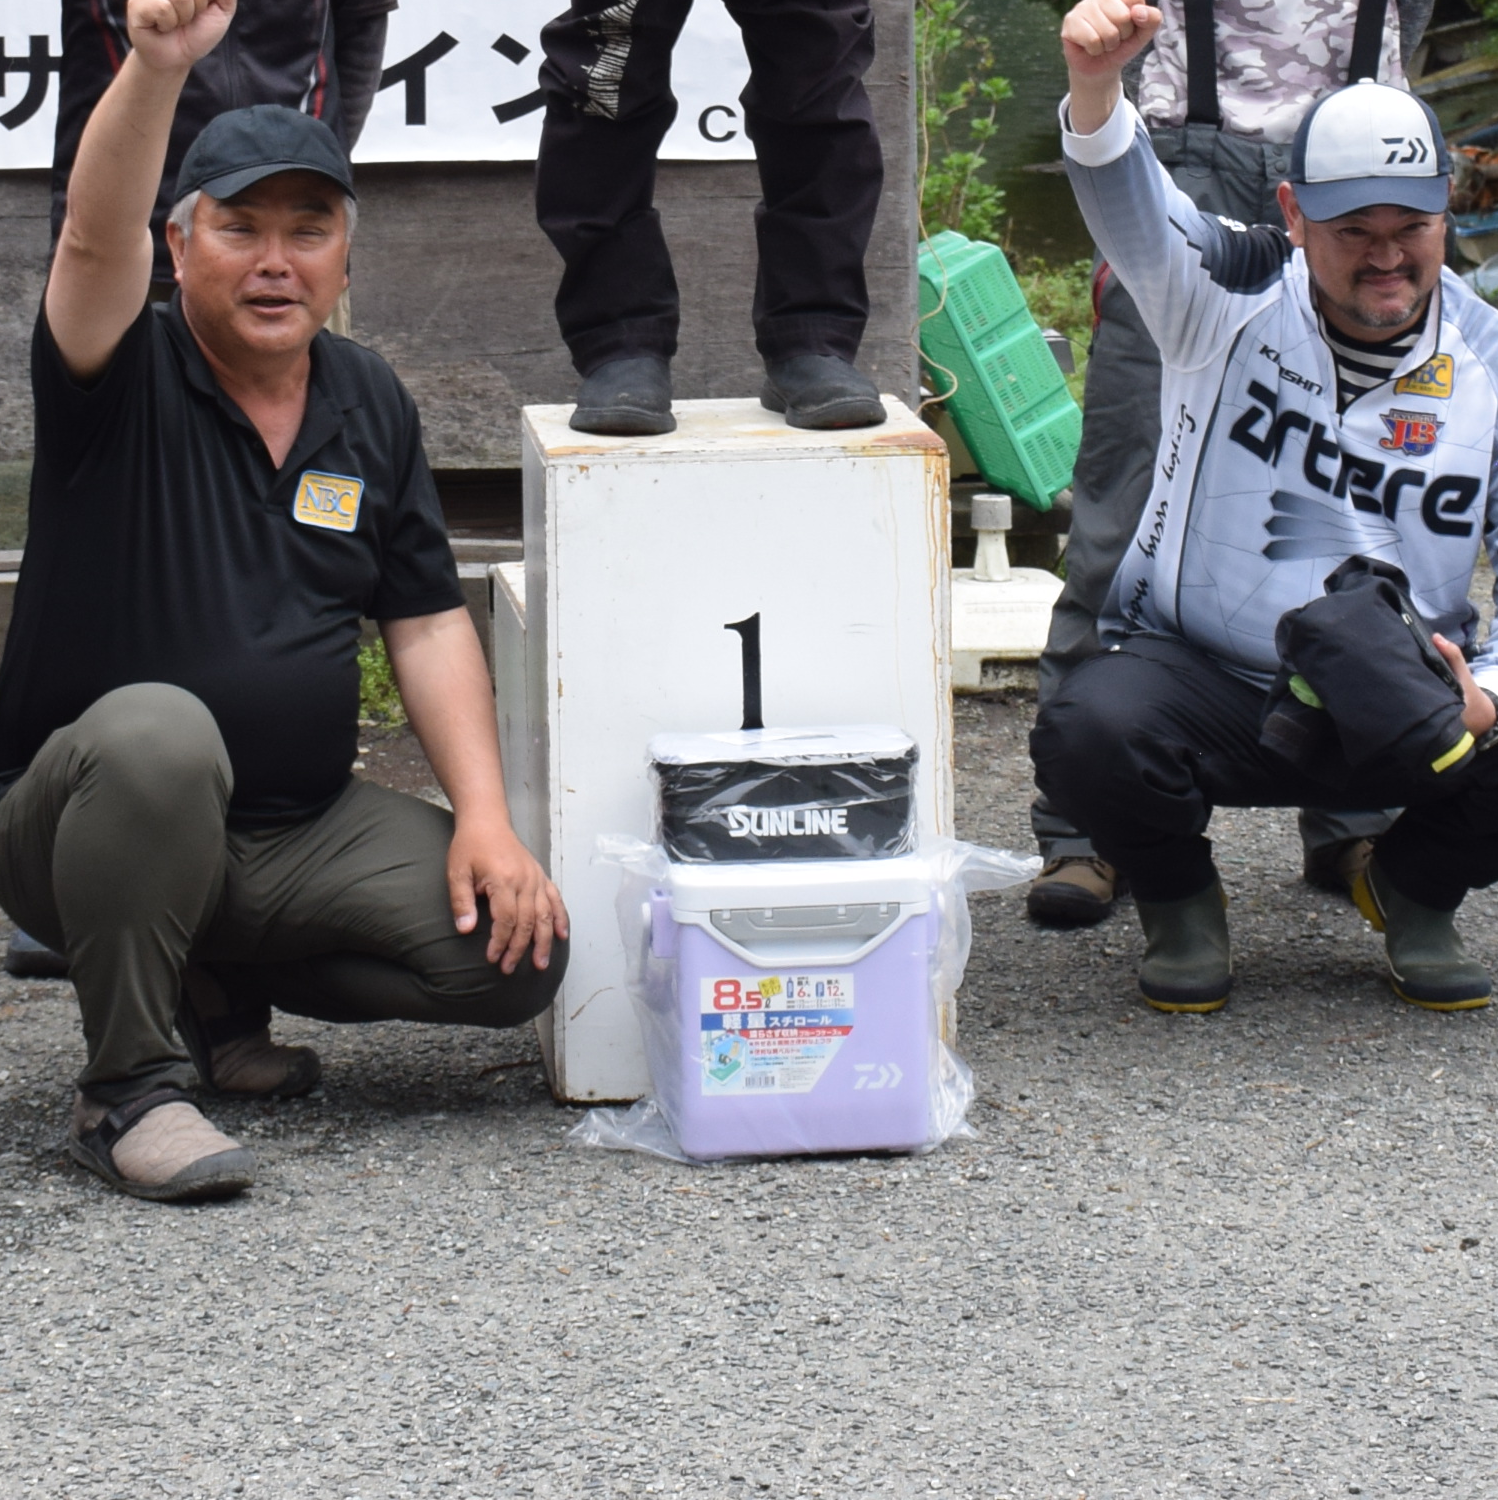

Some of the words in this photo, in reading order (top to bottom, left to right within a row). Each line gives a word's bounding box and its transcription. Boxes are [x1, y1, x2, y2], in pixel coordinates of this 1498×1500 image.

[1409, 363, 1448, 387] BC
[1379, 419, 1438, 450] JB
[301, 484, 354, 518] NBC
[724, 611, 764, 731] 1
[728, 806, 848, 838] SUNLINE
[713, 979, 762, 1011] 8.5
